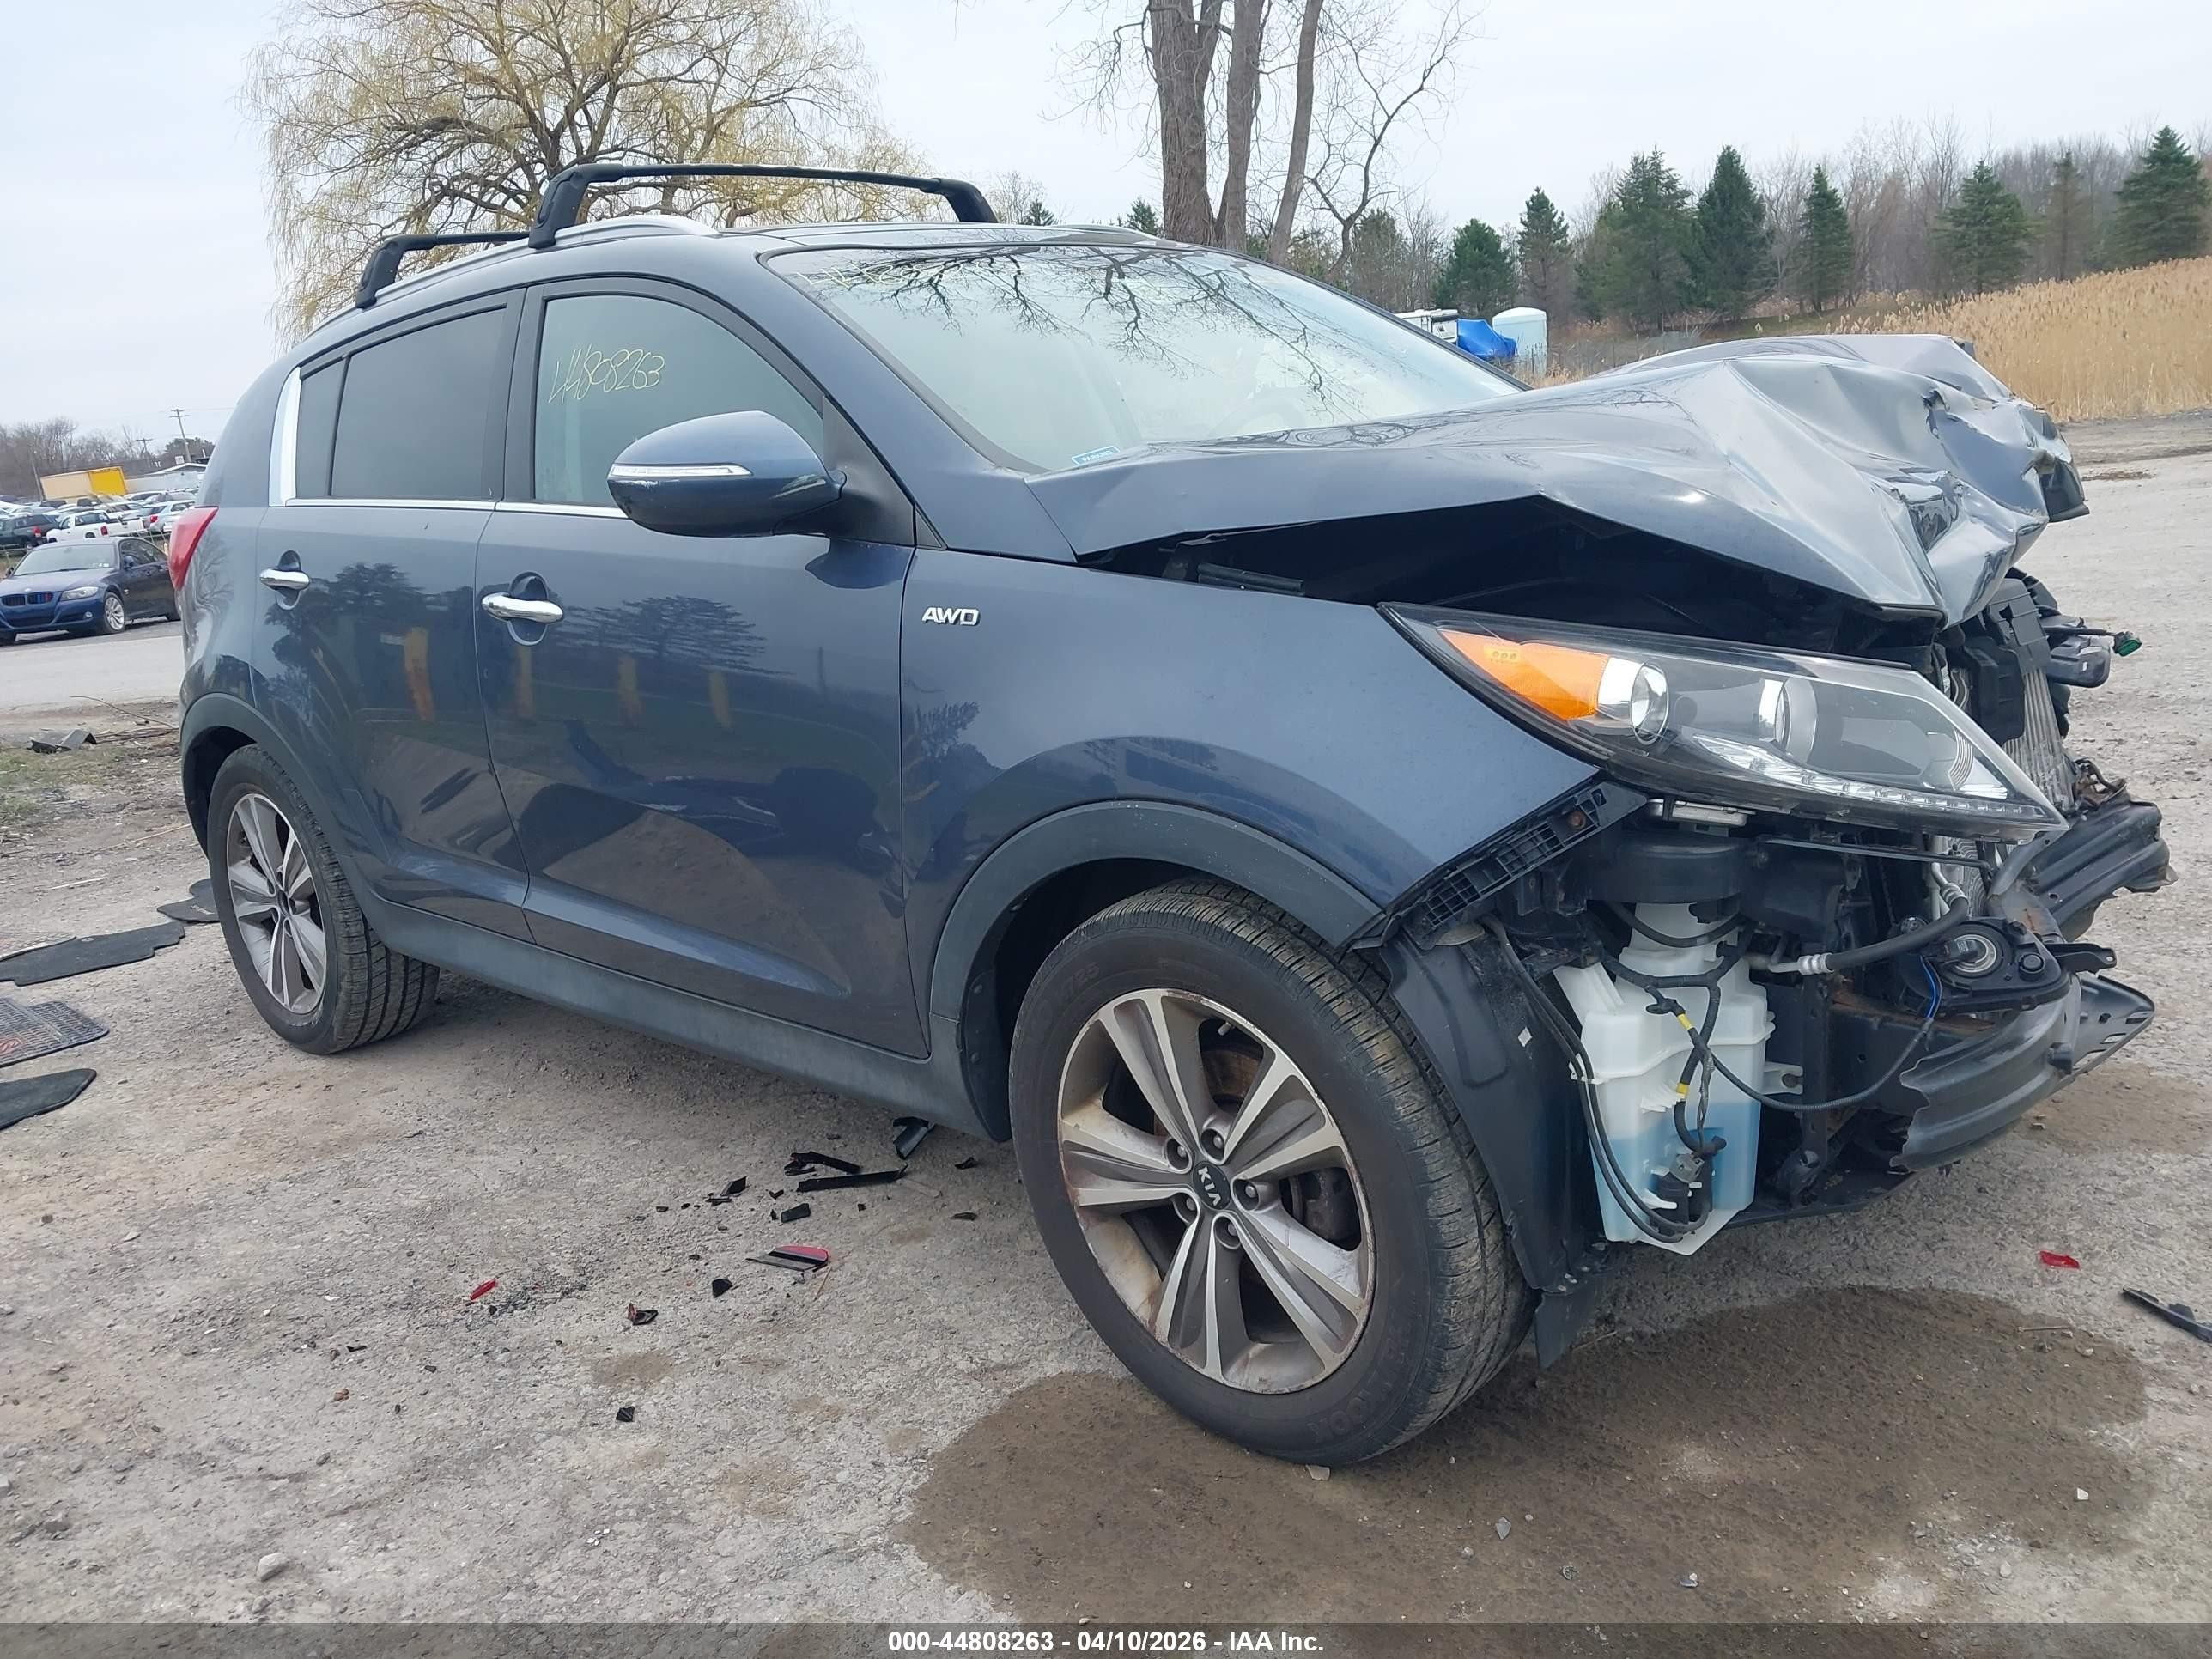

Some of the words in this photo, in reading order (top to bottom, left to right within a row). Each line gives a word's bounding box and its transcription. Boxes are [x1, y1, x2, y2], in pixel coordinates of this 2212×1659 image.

[548, 343, 666, 404] 44808263
[921, 606, 981, 626] AWD
[1198, 1166, 1222, 1206] KIA
